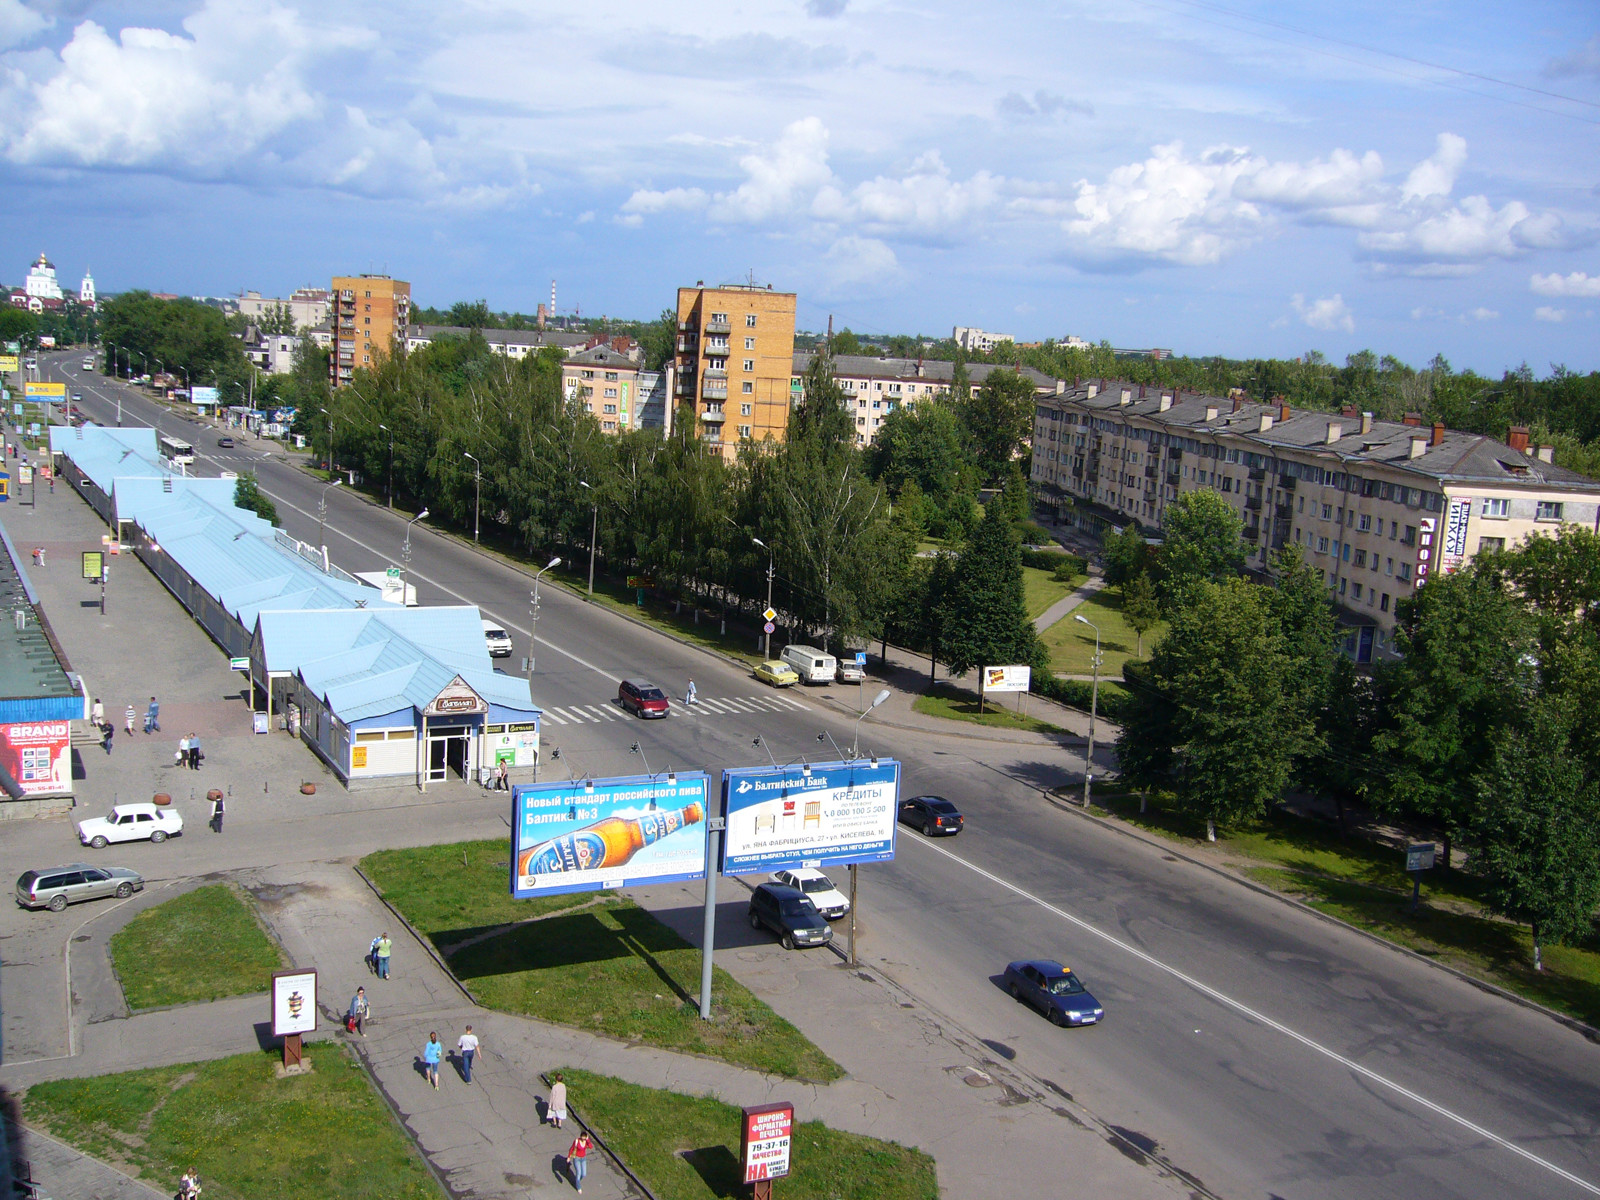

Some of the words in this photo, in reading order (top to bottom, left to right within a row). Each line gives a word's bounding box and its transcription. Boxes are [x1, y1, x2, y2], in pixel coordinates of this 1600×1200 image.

[1446, 504, 1460, 553] КУХНИ
[10, 724, 67, 737] BRAND
[755, 779, 806, 791] Балтийский
[807, 776, 828, 786] Банк
[526, 797, 562, 809] Новый
[564, 792, 611, 806] стандарт
[613, 788, 677, 803] российского
[679, 786, 702, 796] пива
[833, 789, 882, 801] КРЕДИТЫ
[526, 812, 577, 825] Балтика
[757, 1112, 787, 1124] ШИРОКО-
[752, 1119, 791, 1132] ФОРМАТНАЯ
[759, 1128, 783, 1139] ПЕЧАТЬ
[752, 1139, 788, 1152] 79-37-16
[752, 1149, 782, 1160] КАЧЕСТВО
[747, 1162, 768, 1181] НА
